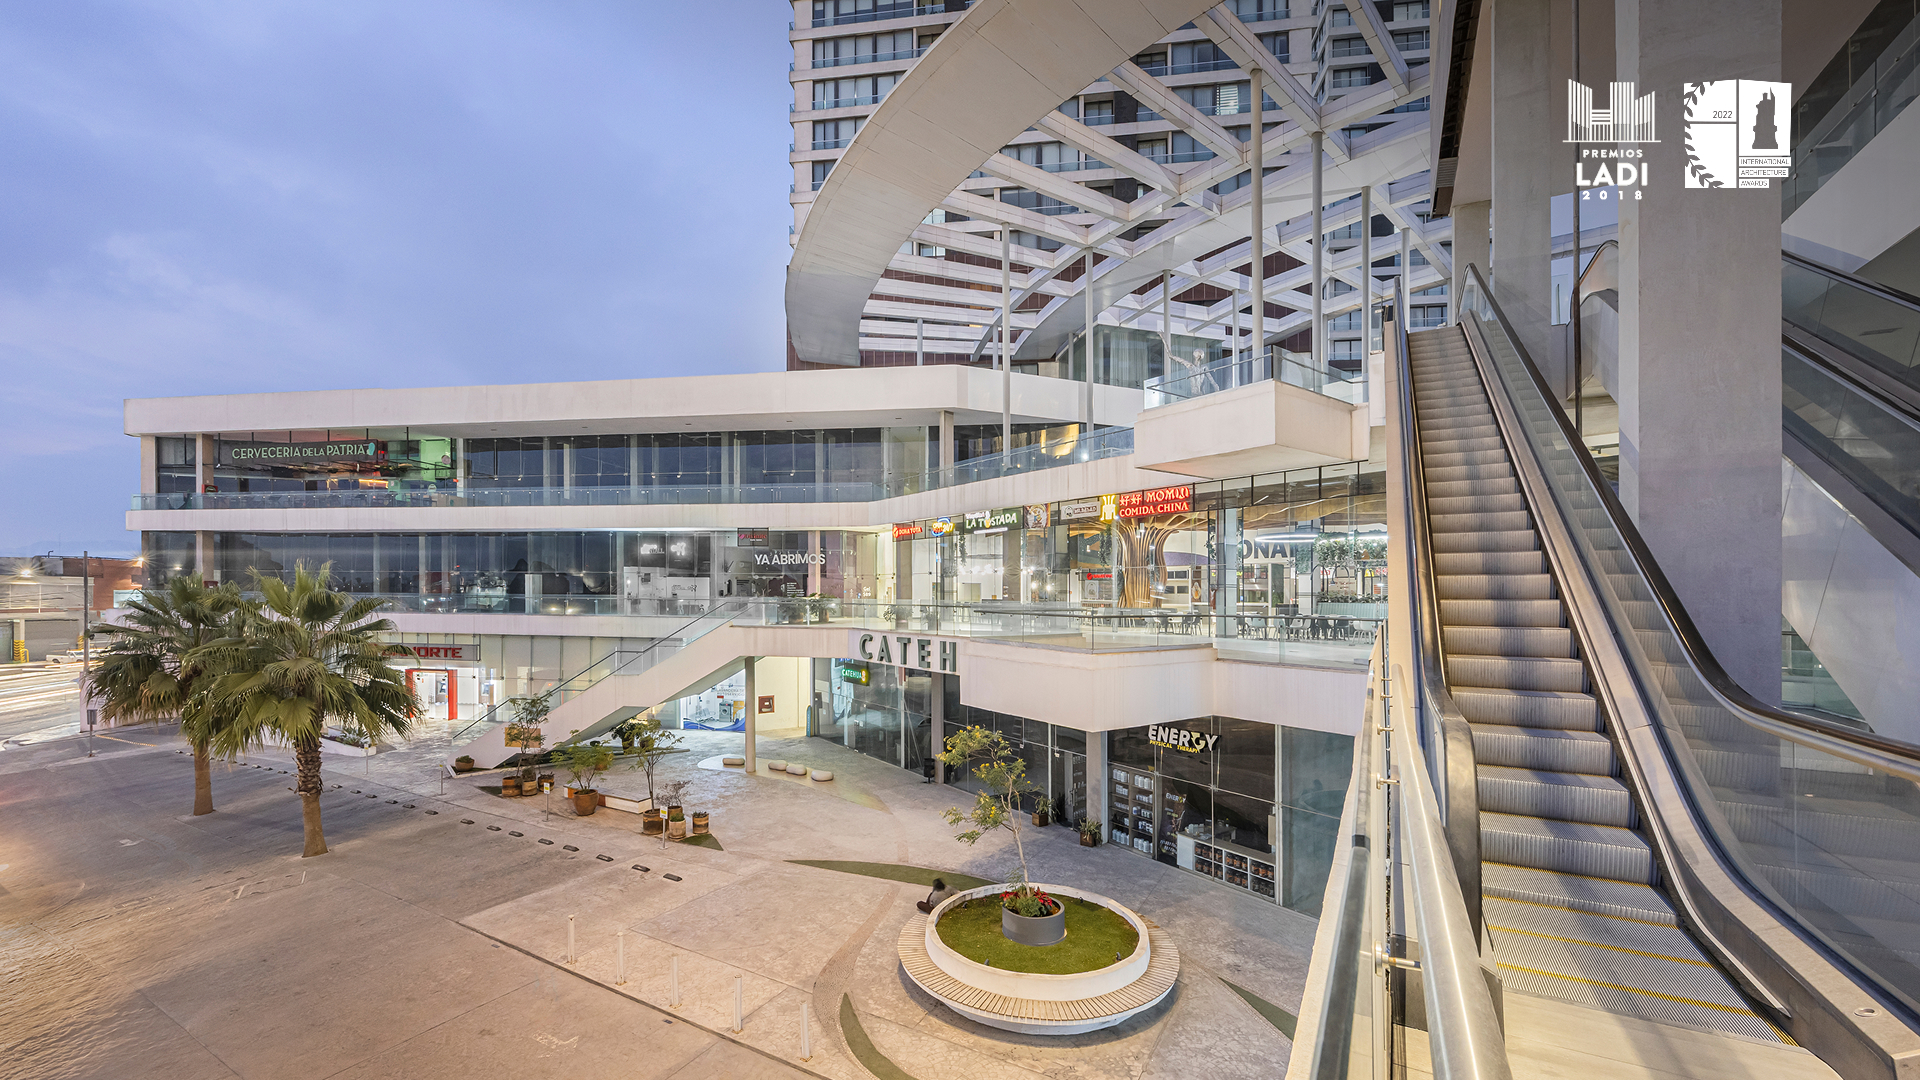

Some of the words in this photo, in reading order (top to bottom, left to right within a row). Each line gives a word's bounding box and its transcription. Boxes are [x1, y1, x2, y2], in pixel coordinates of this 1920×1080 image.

[232, 446, 301, 459] CERVECERIA
[326, 444, 365, 456] PATRIA
[1119, 505, 1155, 518] COMIDA
[1157, 501, 1189, 514] CHINA
[965, 518, 977, 529] LA
[754, 554, 770, 565] YA
[771, 553, 826, 565] ABRIMOS
[859, 633, 957, 672] CATEH
[1148, 724, 1218, 753] ENERGY
[1149, 739, 1173, 749] PHYSICAL
[1177, 744, 1198, 754] THERAPY
